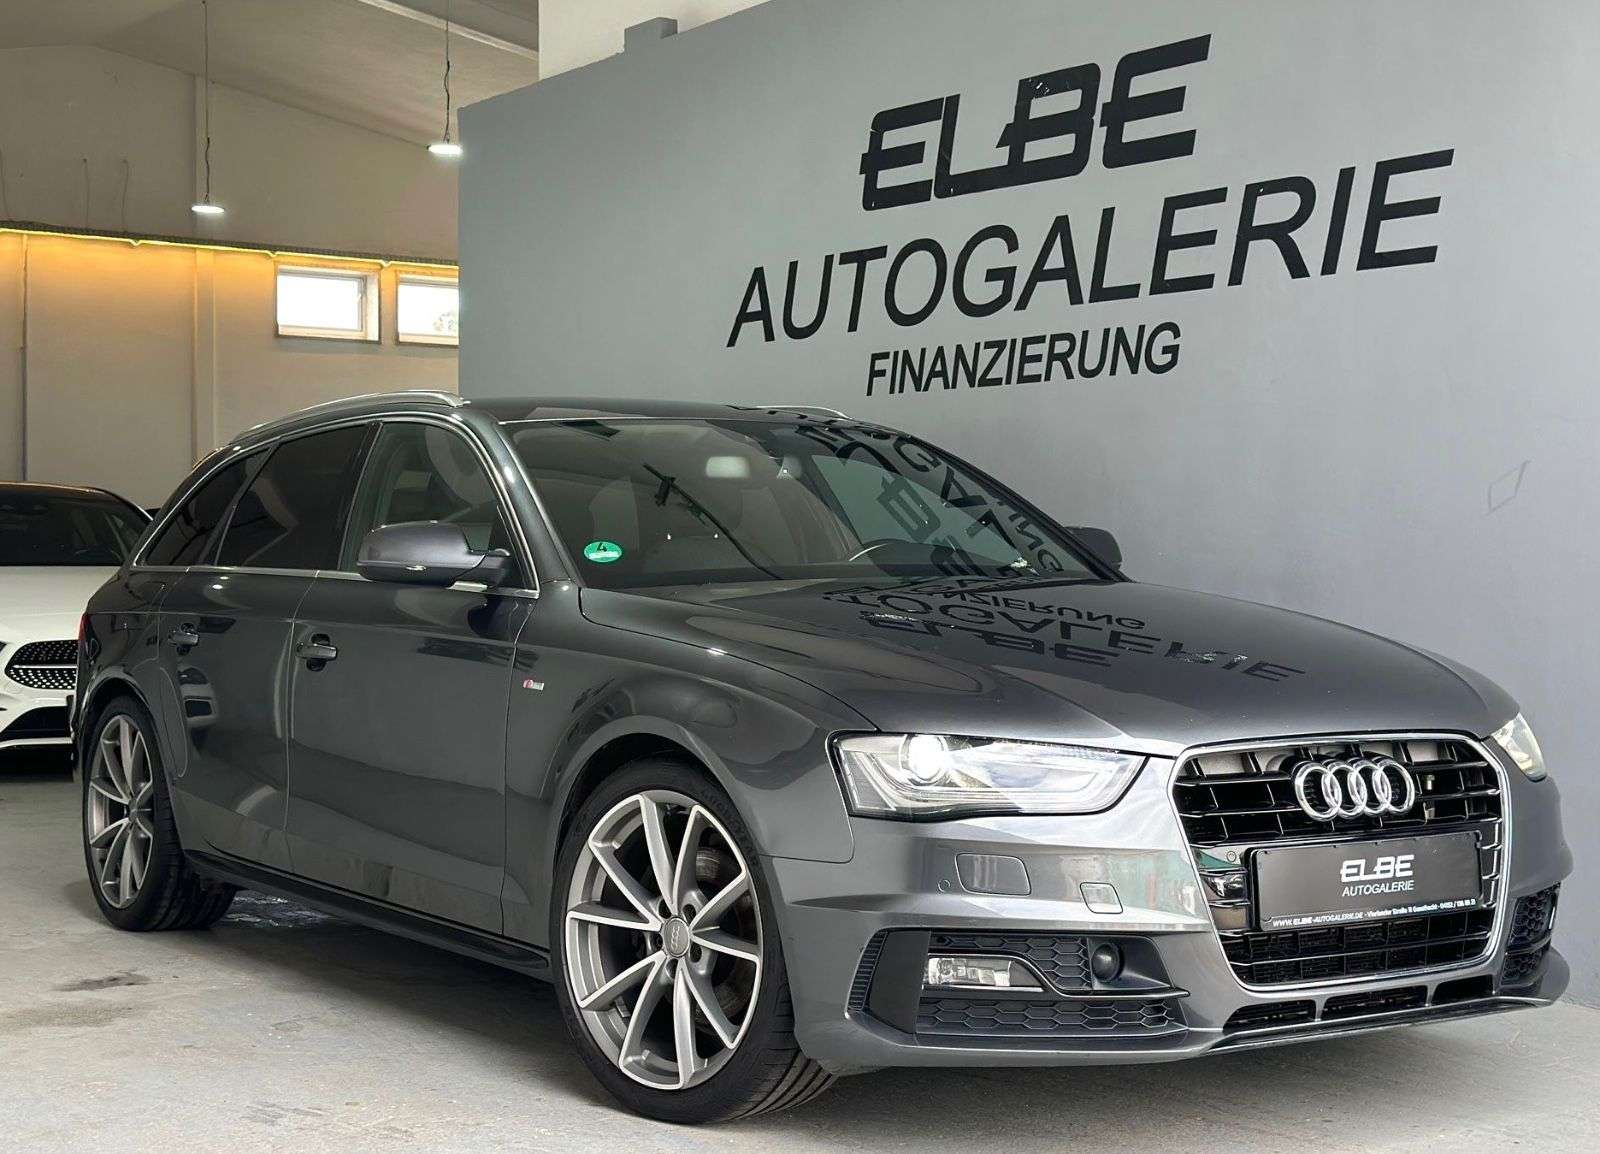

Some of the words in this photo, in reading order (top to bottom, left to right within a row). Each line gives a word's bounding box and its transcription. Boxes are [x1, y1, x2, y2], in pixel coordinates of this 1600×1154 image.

[859, 34, 1212, 211] ELBE
[726, 149, 1455, 348] AUTOGALERIE
[866, 321, 1181, 397] FINANZIERUNG
[597, 542, 608, 552] 4
[1340, 854, 1415, 883] ELBE
[1342, 880, 1415, 897] AUTOGALERIE
